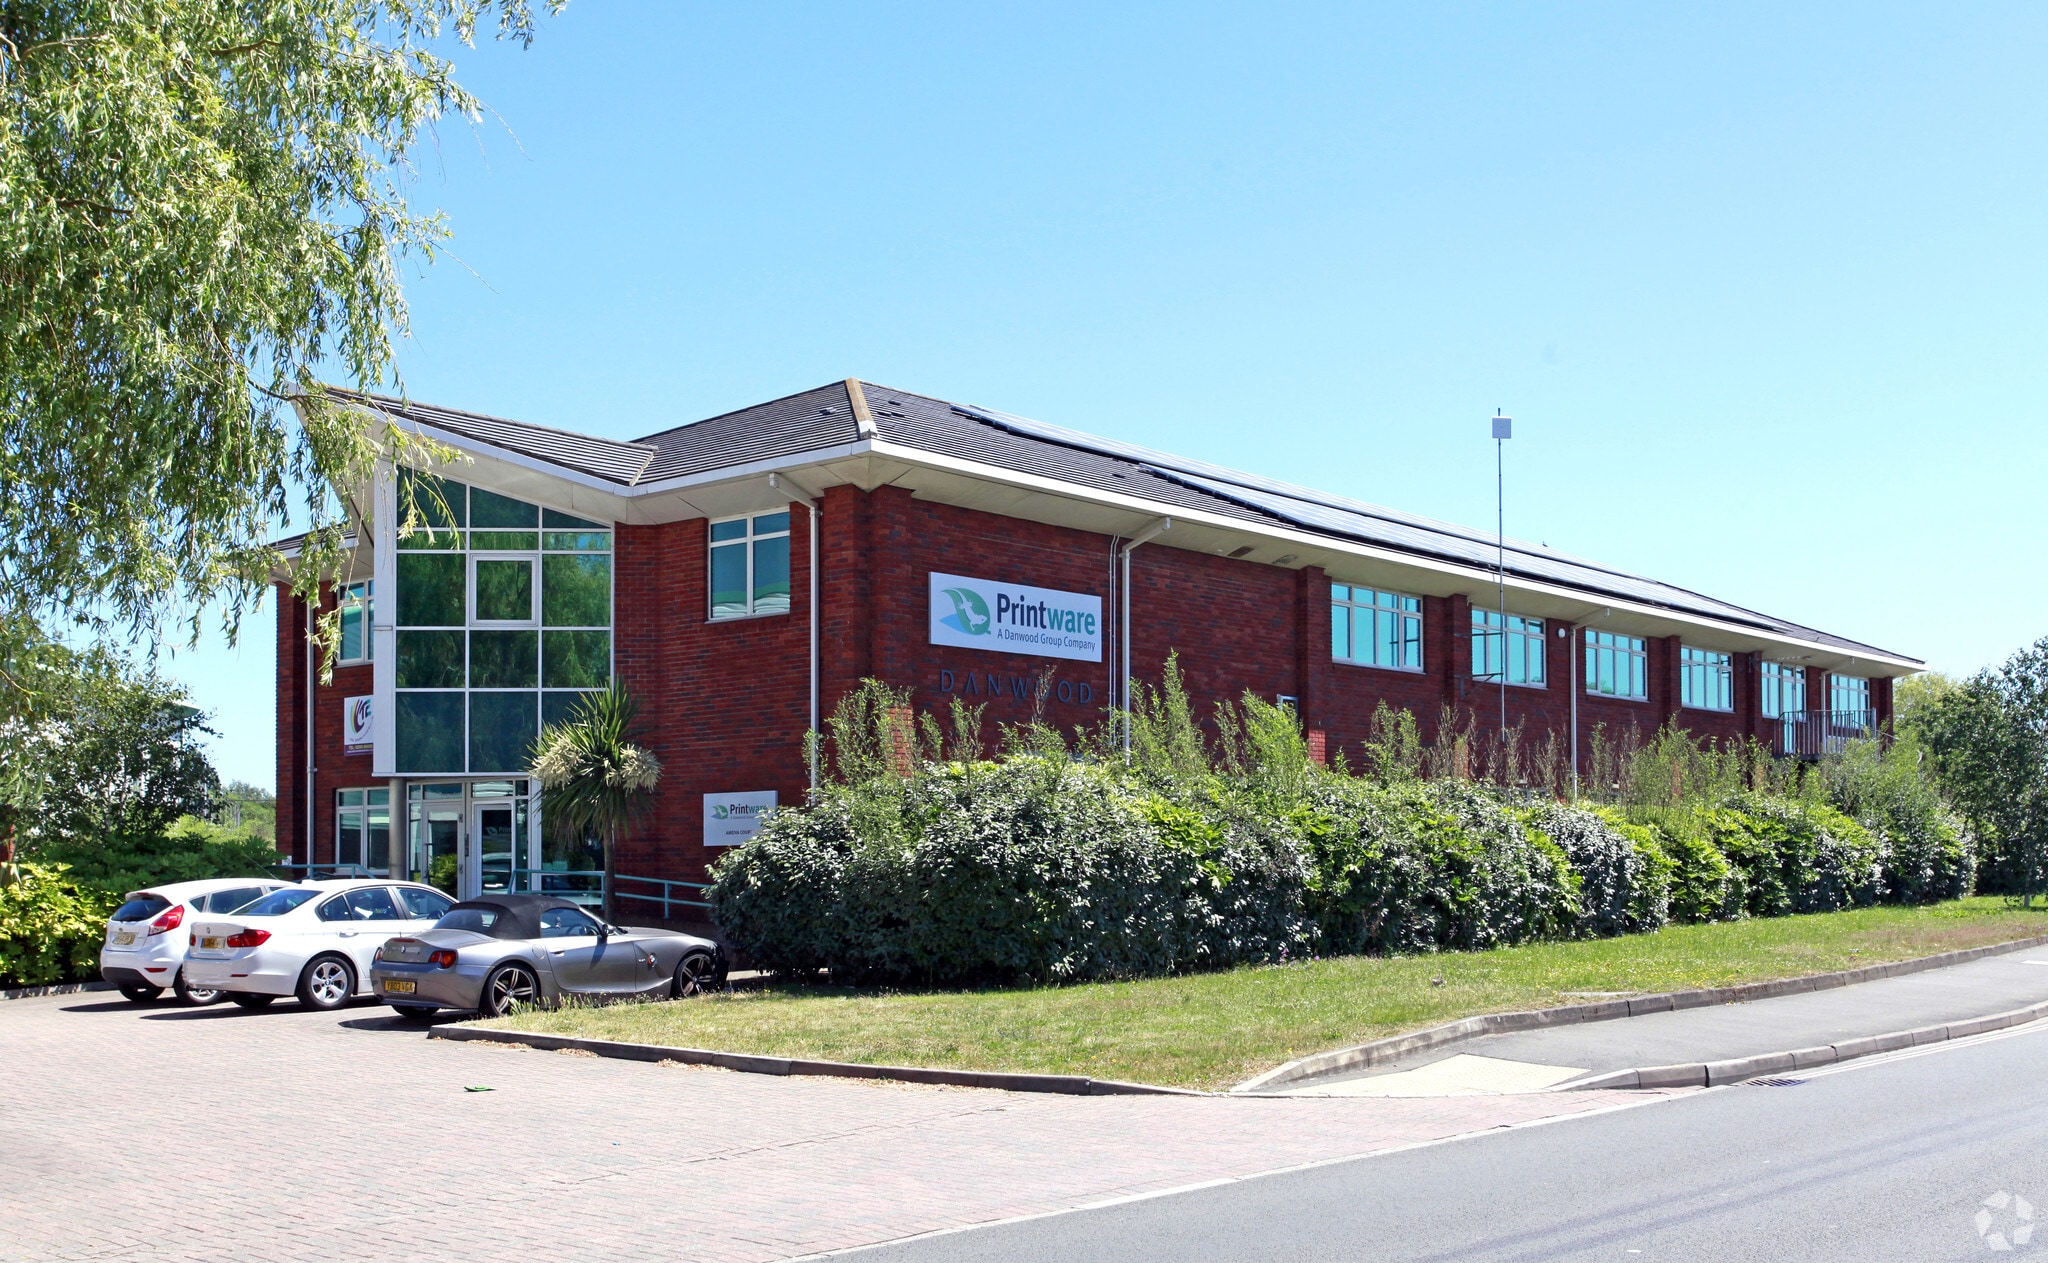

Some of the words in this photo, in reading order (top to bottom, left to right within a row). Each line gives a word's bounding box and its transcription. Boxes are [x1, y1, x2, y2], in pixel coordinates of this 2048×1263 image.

[997, 592, 1096, 636] Printware
[997, 628, 1003, 639] A
[1005, 629, 1039, 644] Danwood
[1040, 633, 1063, 649] Group
[1063, 636, 1096, 652] Company
[940, 669, 1093, 704] DANWOOD
